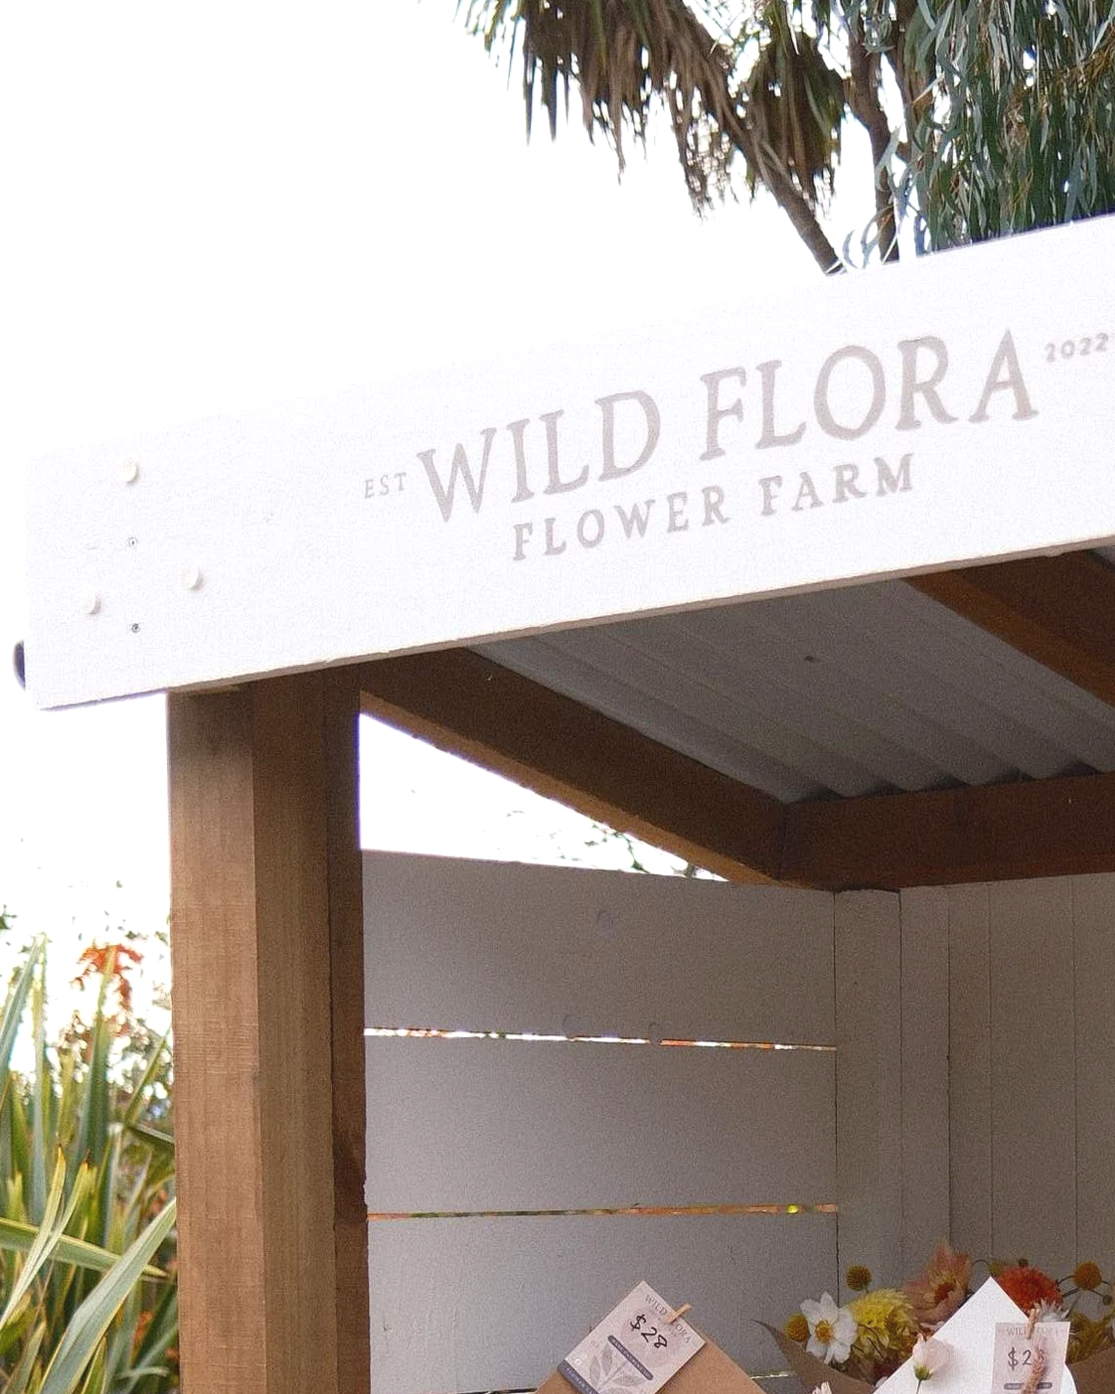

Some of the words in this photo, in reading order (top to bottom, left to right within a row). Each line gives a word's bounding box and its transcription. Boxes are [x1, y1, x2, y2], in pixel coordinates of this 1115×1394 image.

[363, 470, 408, 501] EST
[416, 388, 662, 523] WILD
[699, 327, 1039, 461] FLORA
[1044, 332, 1109, 363] 2022
[511, 485, 731, 561] FLOWER
[758, 452, 915, 517] FARM
[629, 1313, 669, 1350] $28
[646, 1294, 668, 1316] WILD
